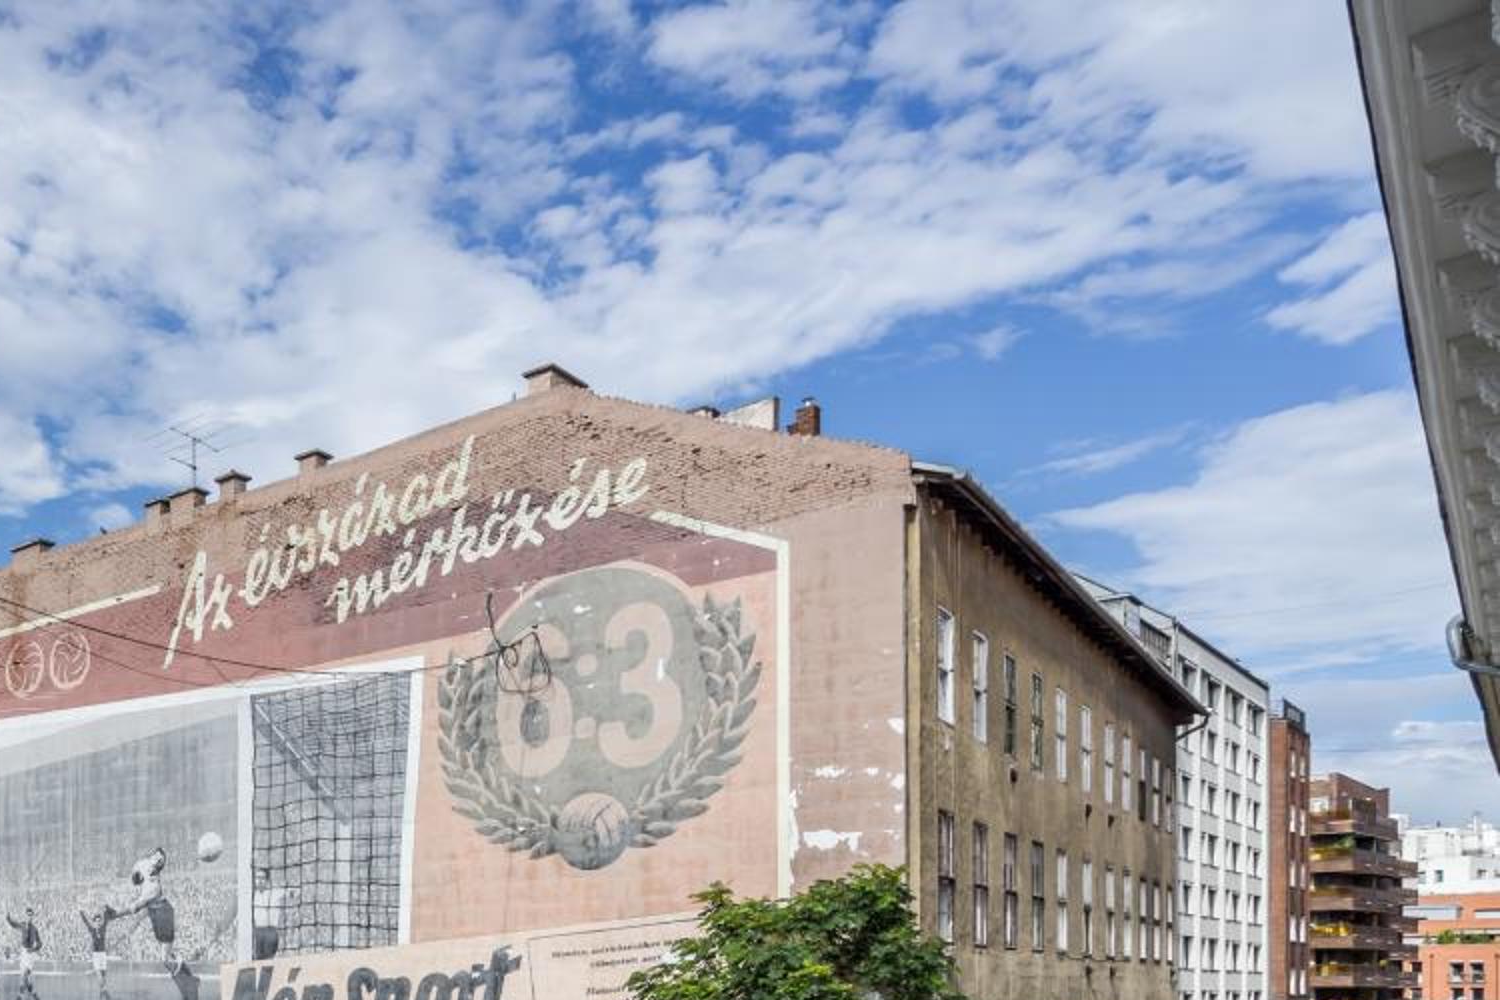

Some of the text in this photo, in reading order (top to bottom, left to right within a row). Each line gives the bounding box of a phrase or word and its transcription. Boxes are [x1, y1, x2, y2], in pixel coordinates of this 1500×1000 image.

[238, 435, 477, 607] évszázad
[326, 456, 649, 625] mérkőzése
[496, 602, 683, 778] 6:3
